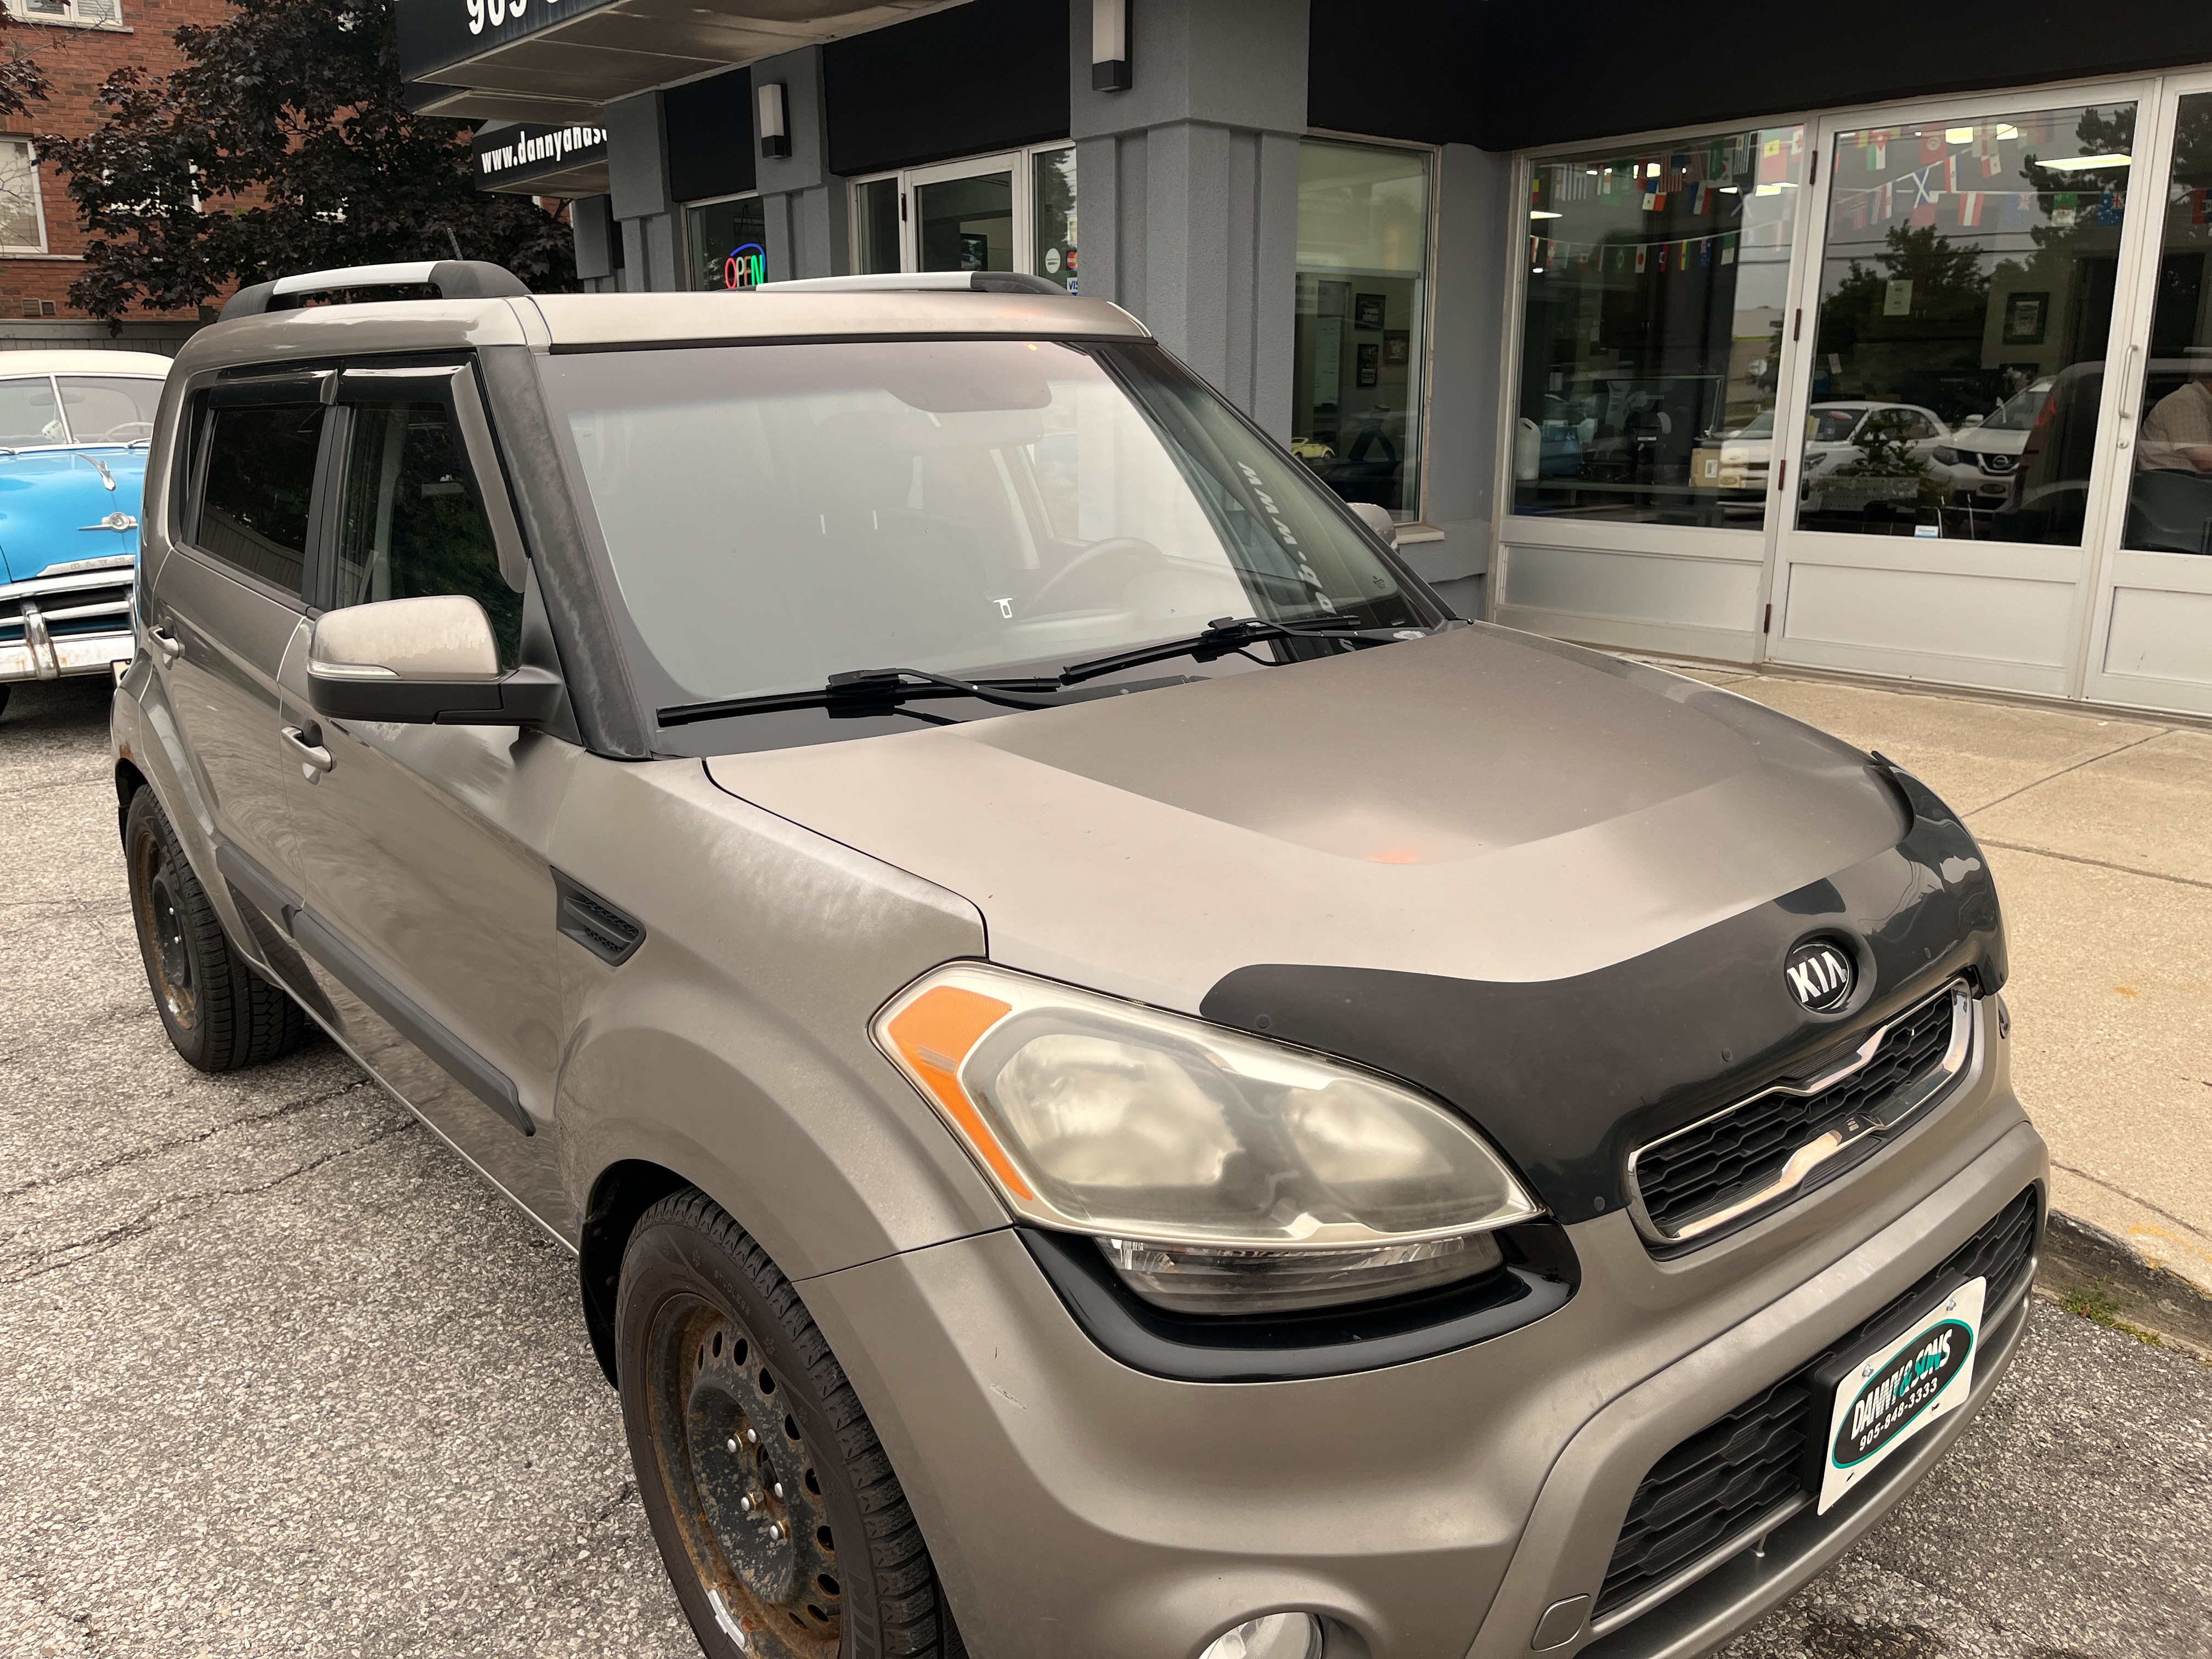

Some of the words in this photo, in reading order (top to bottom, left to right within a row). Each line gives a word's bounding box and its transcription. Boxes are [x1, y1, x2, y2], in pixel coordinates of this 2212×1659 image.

[724, 254, 764, 290] OPEN
[1786, 951, 1847, 1003] KIA
[714, 1269, 752, 1317] STUDLESS
[1850, 1364, 1905, 1441] DANNY
[1899, 1359, 1913, 1397] &
[1910, 1328, 1953, 1388] SONS
[1859, 1377, 1938, 1451] 905-848-3333
